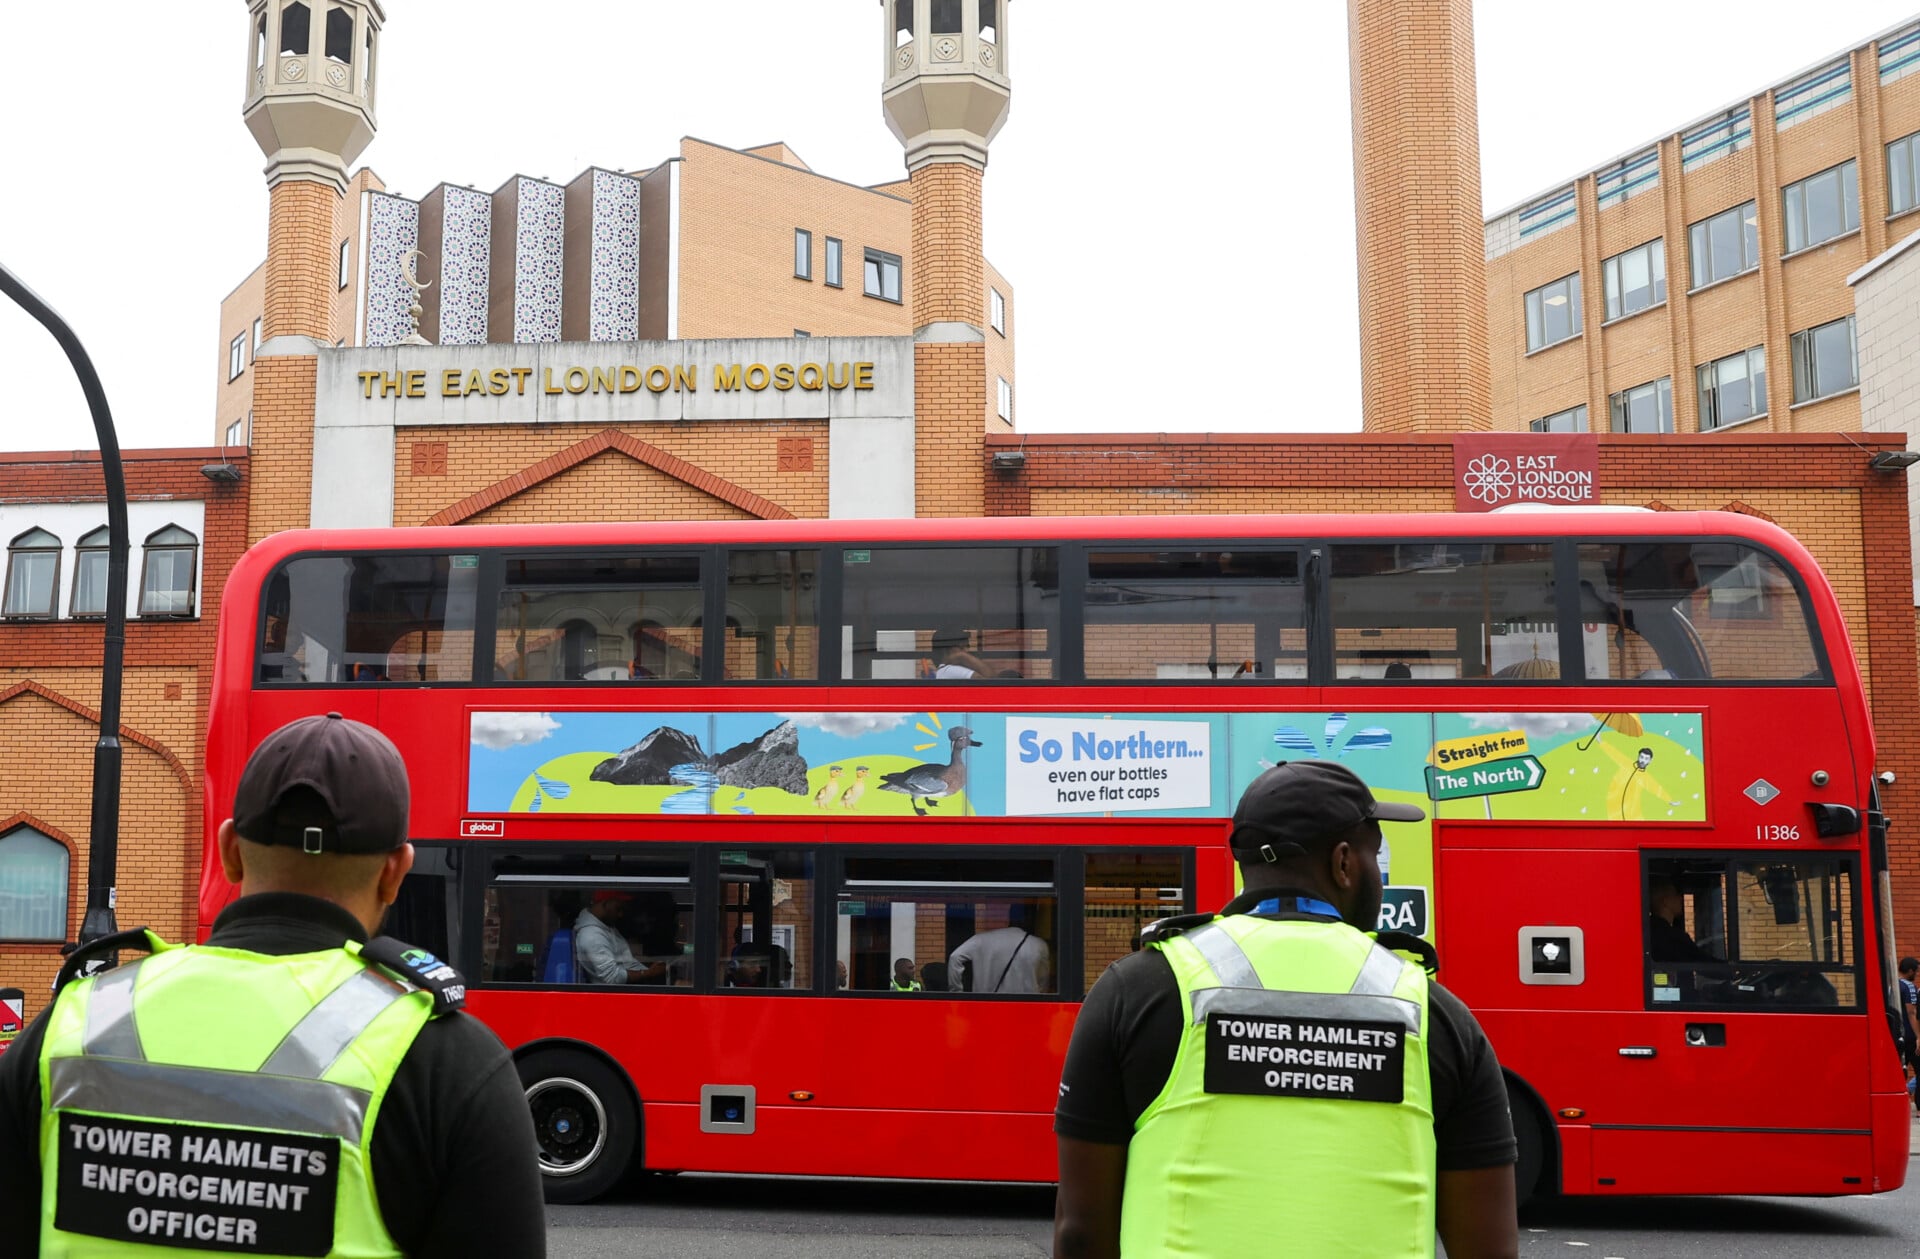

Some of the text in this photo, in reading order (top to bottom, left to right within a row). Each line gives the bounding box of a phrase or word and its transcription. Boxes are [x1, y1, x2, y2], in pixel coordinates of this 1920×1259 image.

[358, 362, 875, 398] THE EAST LONDON MOSQUE
[1516, 455, 1557, 469] EAST
[1517, 470, 1592, 485] LONDON
[1518, 485, 1593, 502] MOSQUE
[1018, 729, 1204, 764] So Northern...
[1437, 737, 1525, 764] Straight from
[1049, 766, 1168, 783] even our bottles
[1435, 766, 1525, 790] The North
[1057, 785, 1160, 803] have flat caps
[469, 822, 496, 834] global
[1756, 825, 1800, 840] 11386
[1377, 900, 1417, 930] RA
[1217, 1020, 1397, 1049] TOWER HAMLETS
[1227, 1045, 1387, 1071] ENFORCEMENT
[1264, 1070, 1355, 1093] OFFICER
[69, 1124, 328, 1177] TOWER HAMLETS
[81, 1163, 310, 1212] ENFORCEMENT
[127, 1207, 258, 1245] OFFICER
